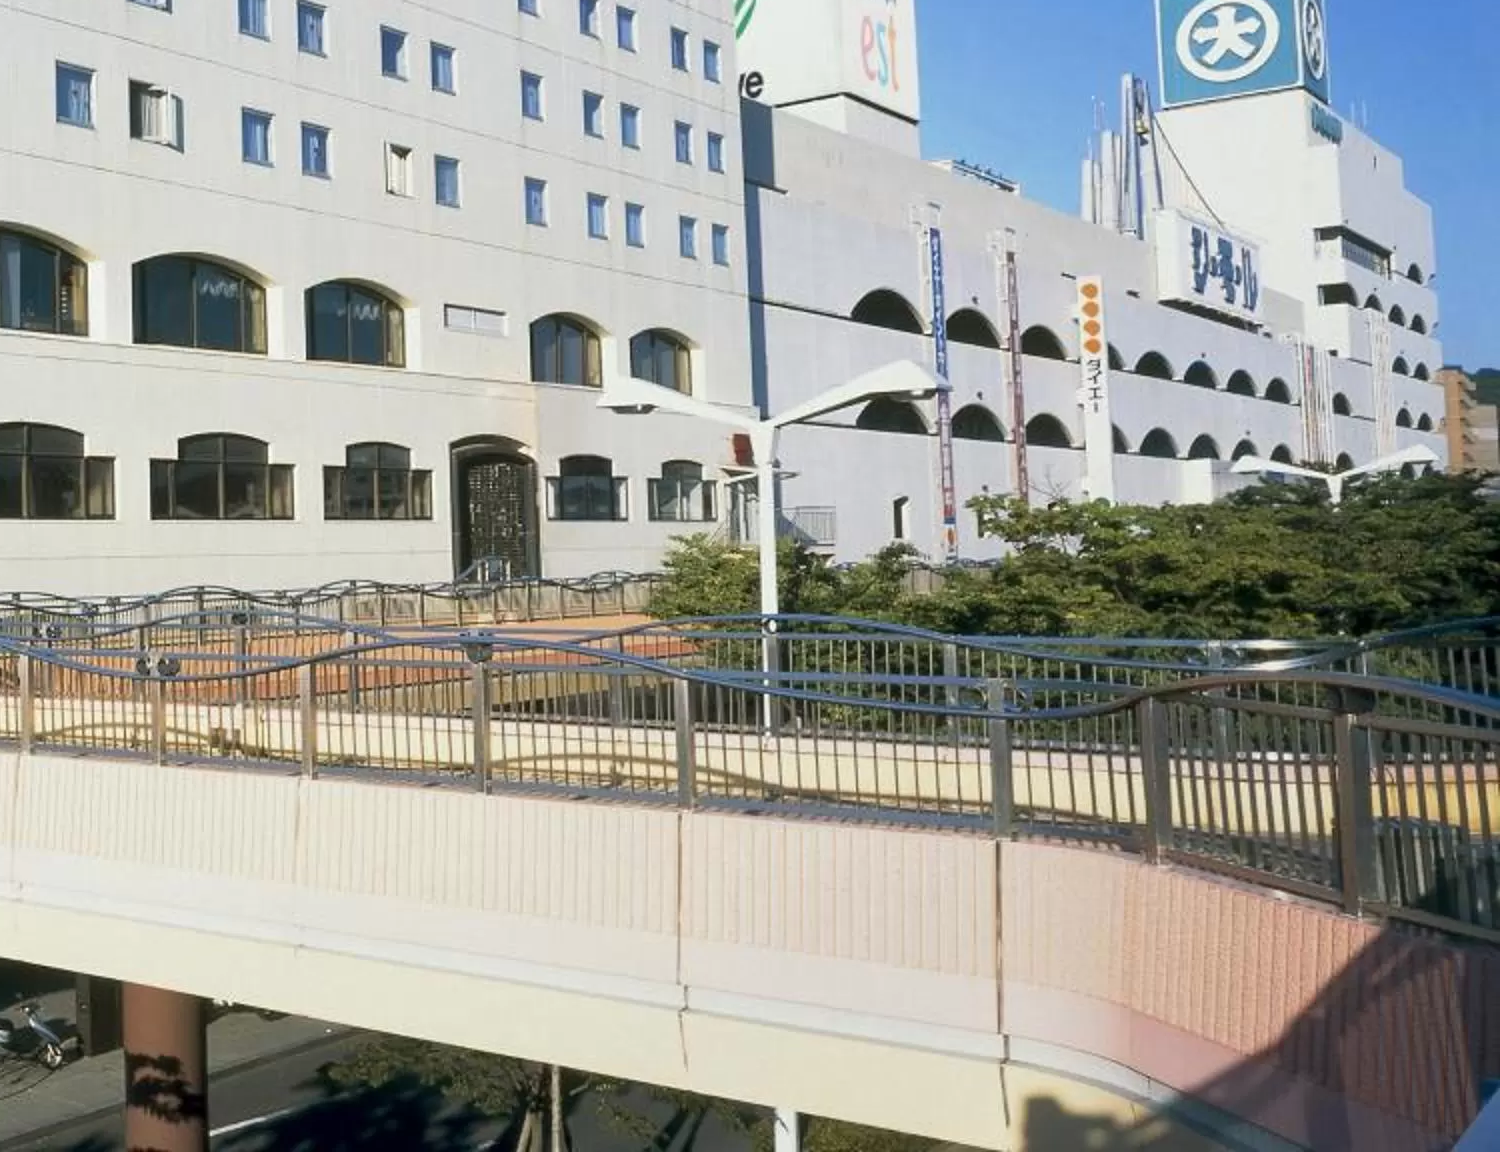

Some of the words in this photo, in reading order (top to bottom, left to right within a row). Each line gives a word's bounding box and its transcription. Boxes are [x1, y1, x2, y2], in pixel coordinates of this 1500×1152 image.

[861, 15, 901, 93] est
[1087, 358, 1104, 414] ダイエー
